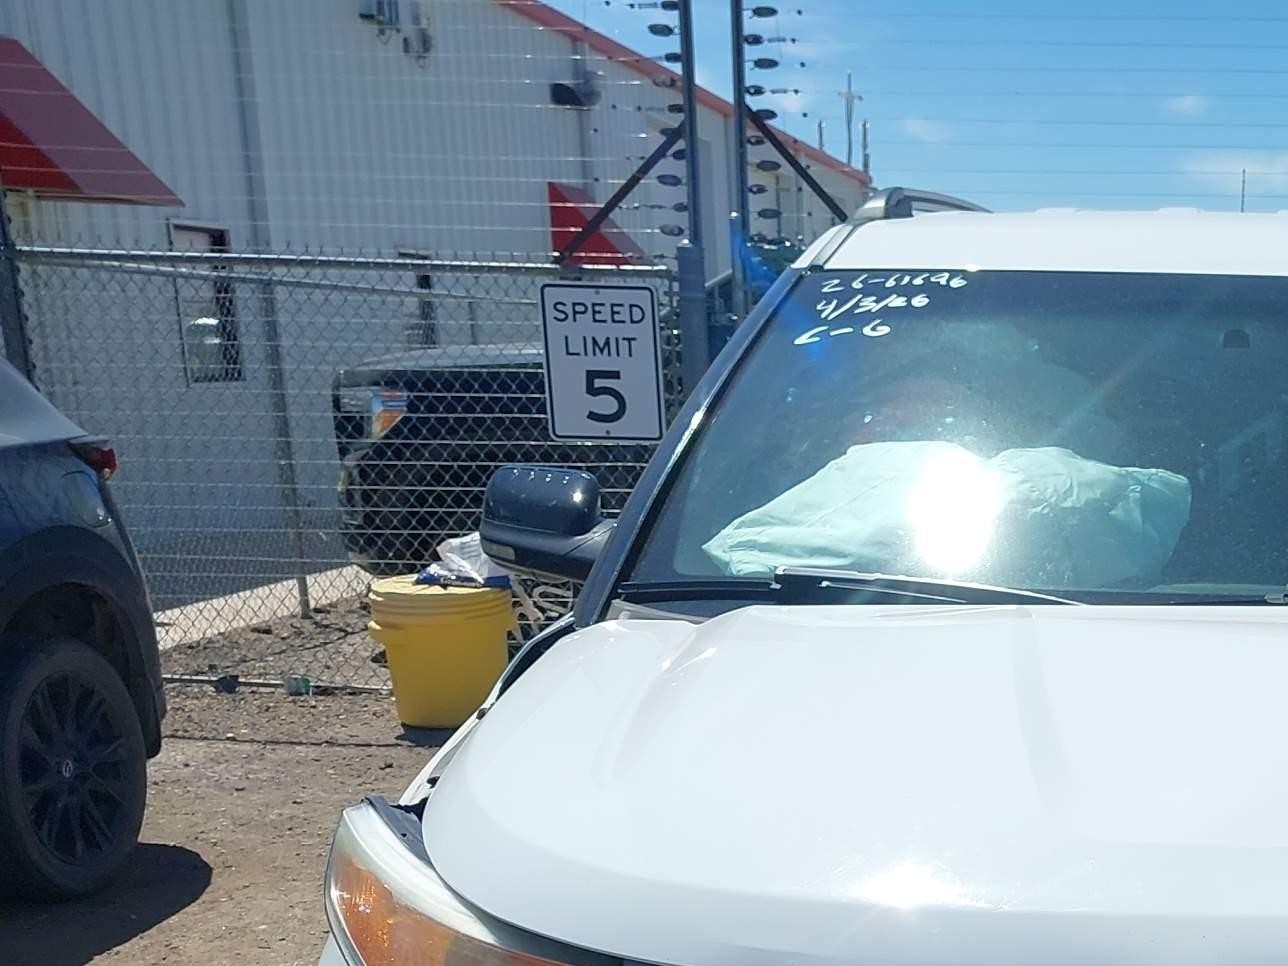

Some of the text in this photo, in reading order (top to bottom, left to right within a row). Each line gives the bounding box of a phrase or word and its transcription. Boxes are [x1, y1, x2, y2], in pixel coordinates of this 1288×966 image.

[553, 301, 646, 325] SPEED
[564, 335, 638, 358] LIMIT
[585, 369, 628, 424] 5
